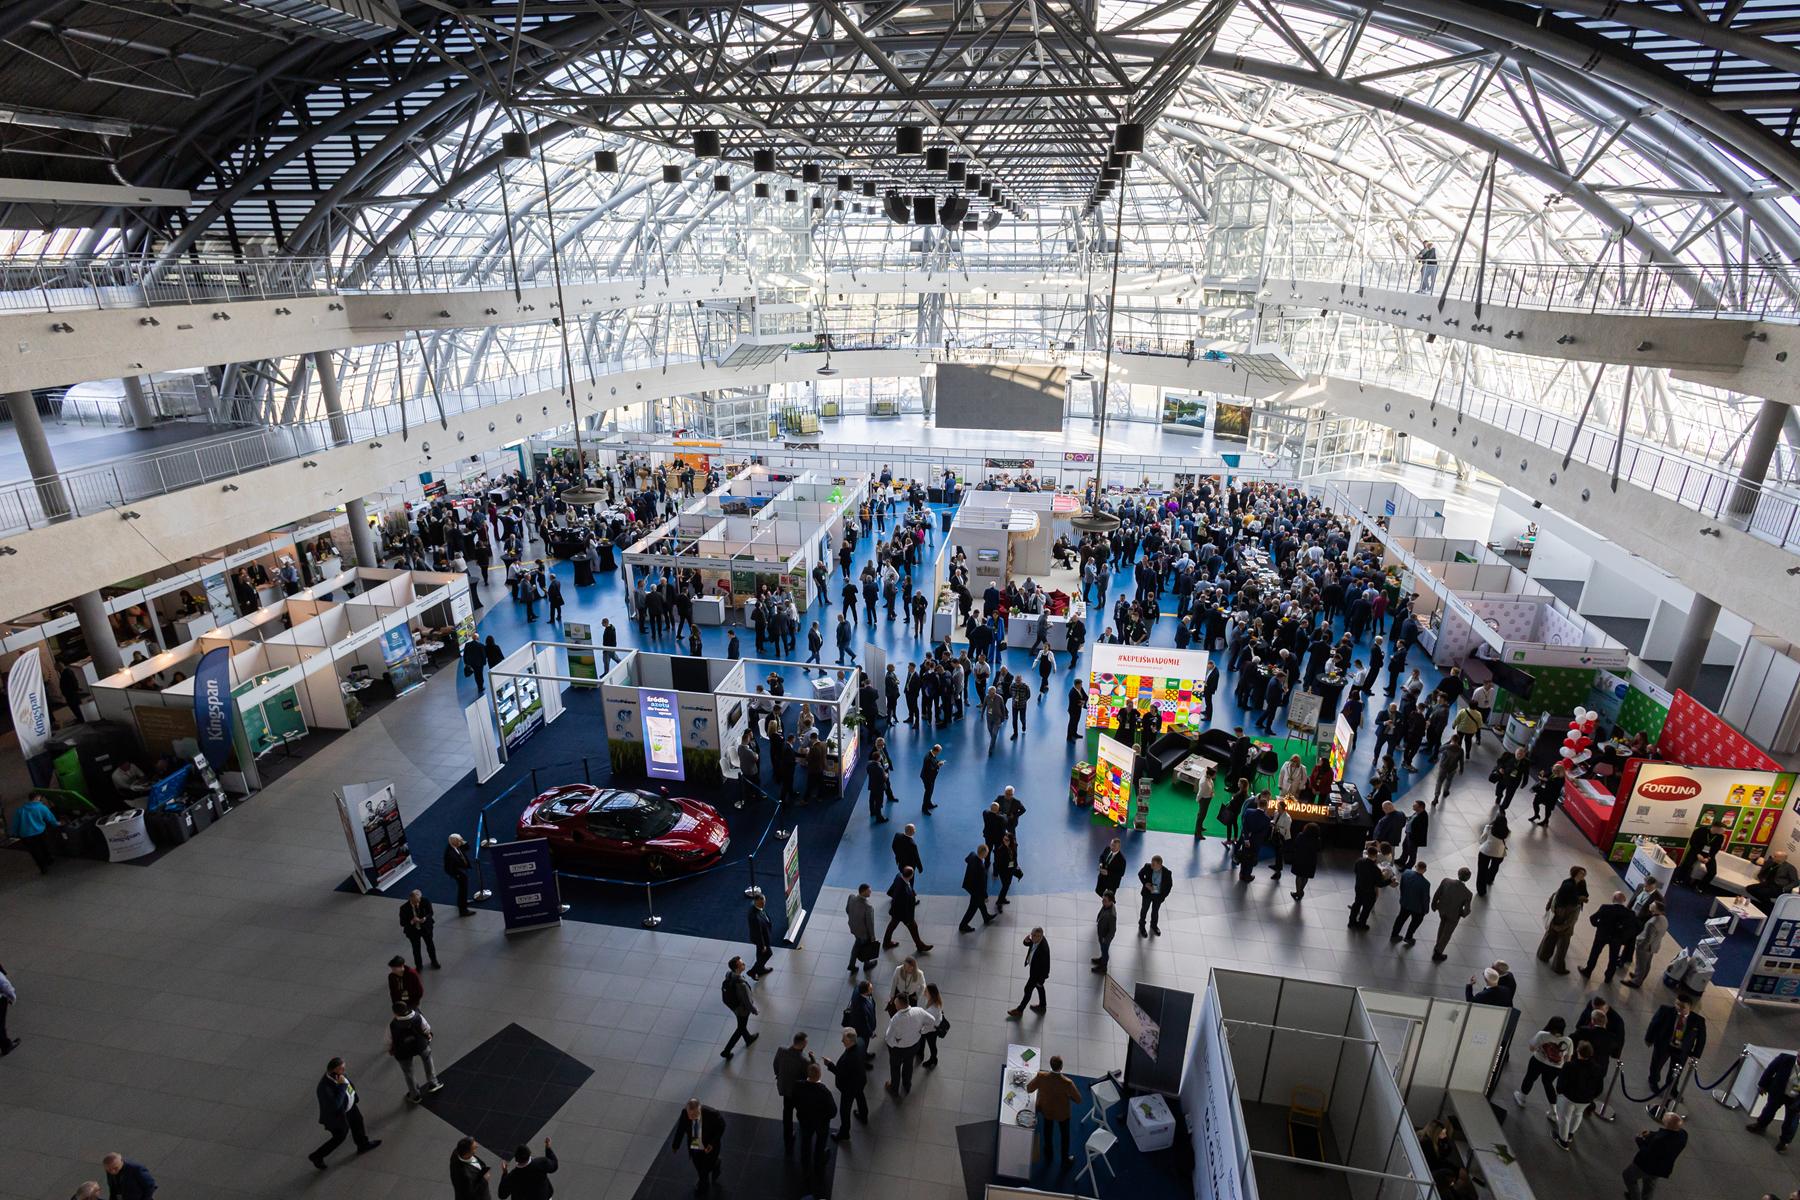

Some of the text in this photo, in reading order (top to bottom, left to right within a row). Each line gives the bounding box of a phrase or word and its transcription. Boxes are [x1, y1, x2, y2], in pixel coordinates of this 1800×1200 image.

[29, 692, 46, 737] Kingspan
[206, 679, 224, 741] Kingspan
[1642, 783, 1696, 796] FORTUNA
